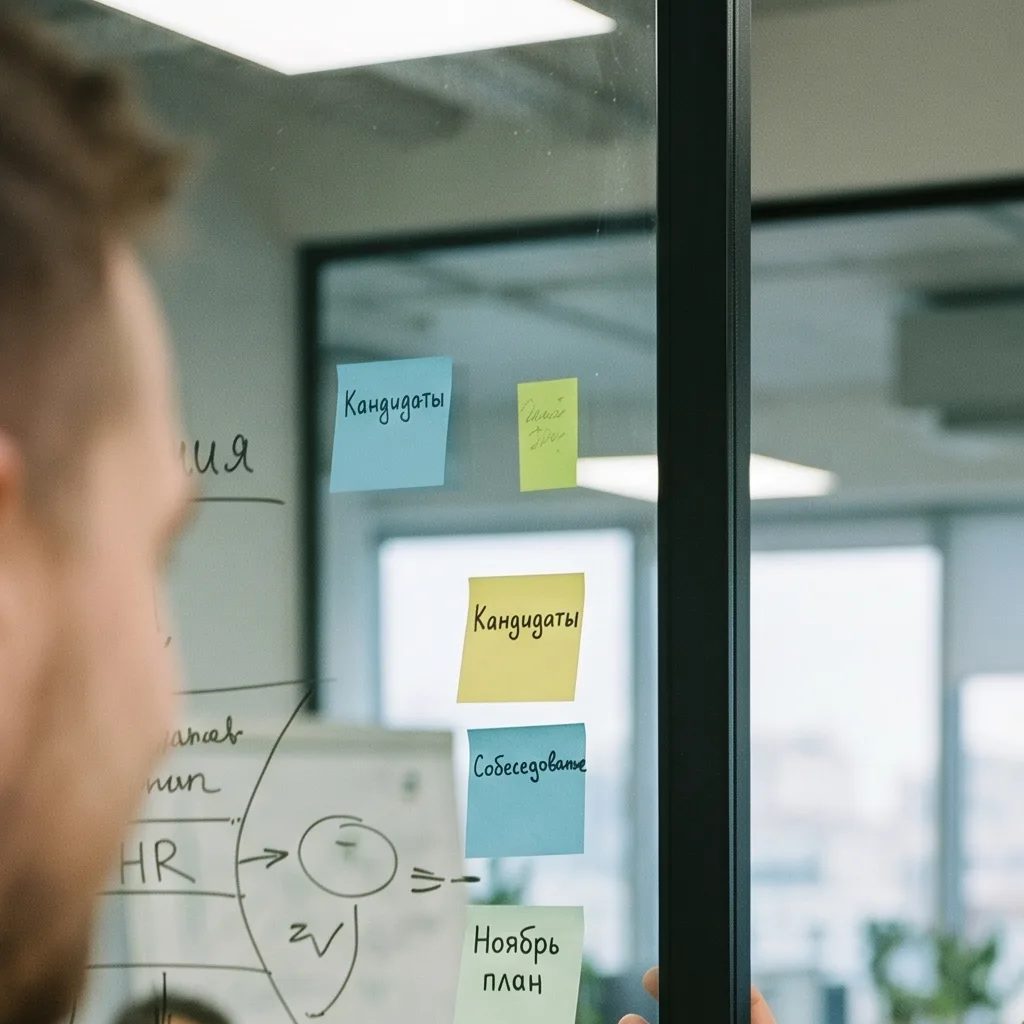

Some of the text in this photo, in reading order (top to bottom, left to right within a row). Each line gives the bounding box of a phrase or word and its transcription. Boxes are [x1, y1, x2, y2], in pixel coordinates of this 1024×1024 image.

[344, 389, 444, 425] Кандидаты
[473, 603, 579, 641] Кандидаты
[120, 839, 197, 885] HR
[474, 924, 560, 965] Ноябрь
[483, 973, 542, 995] план
